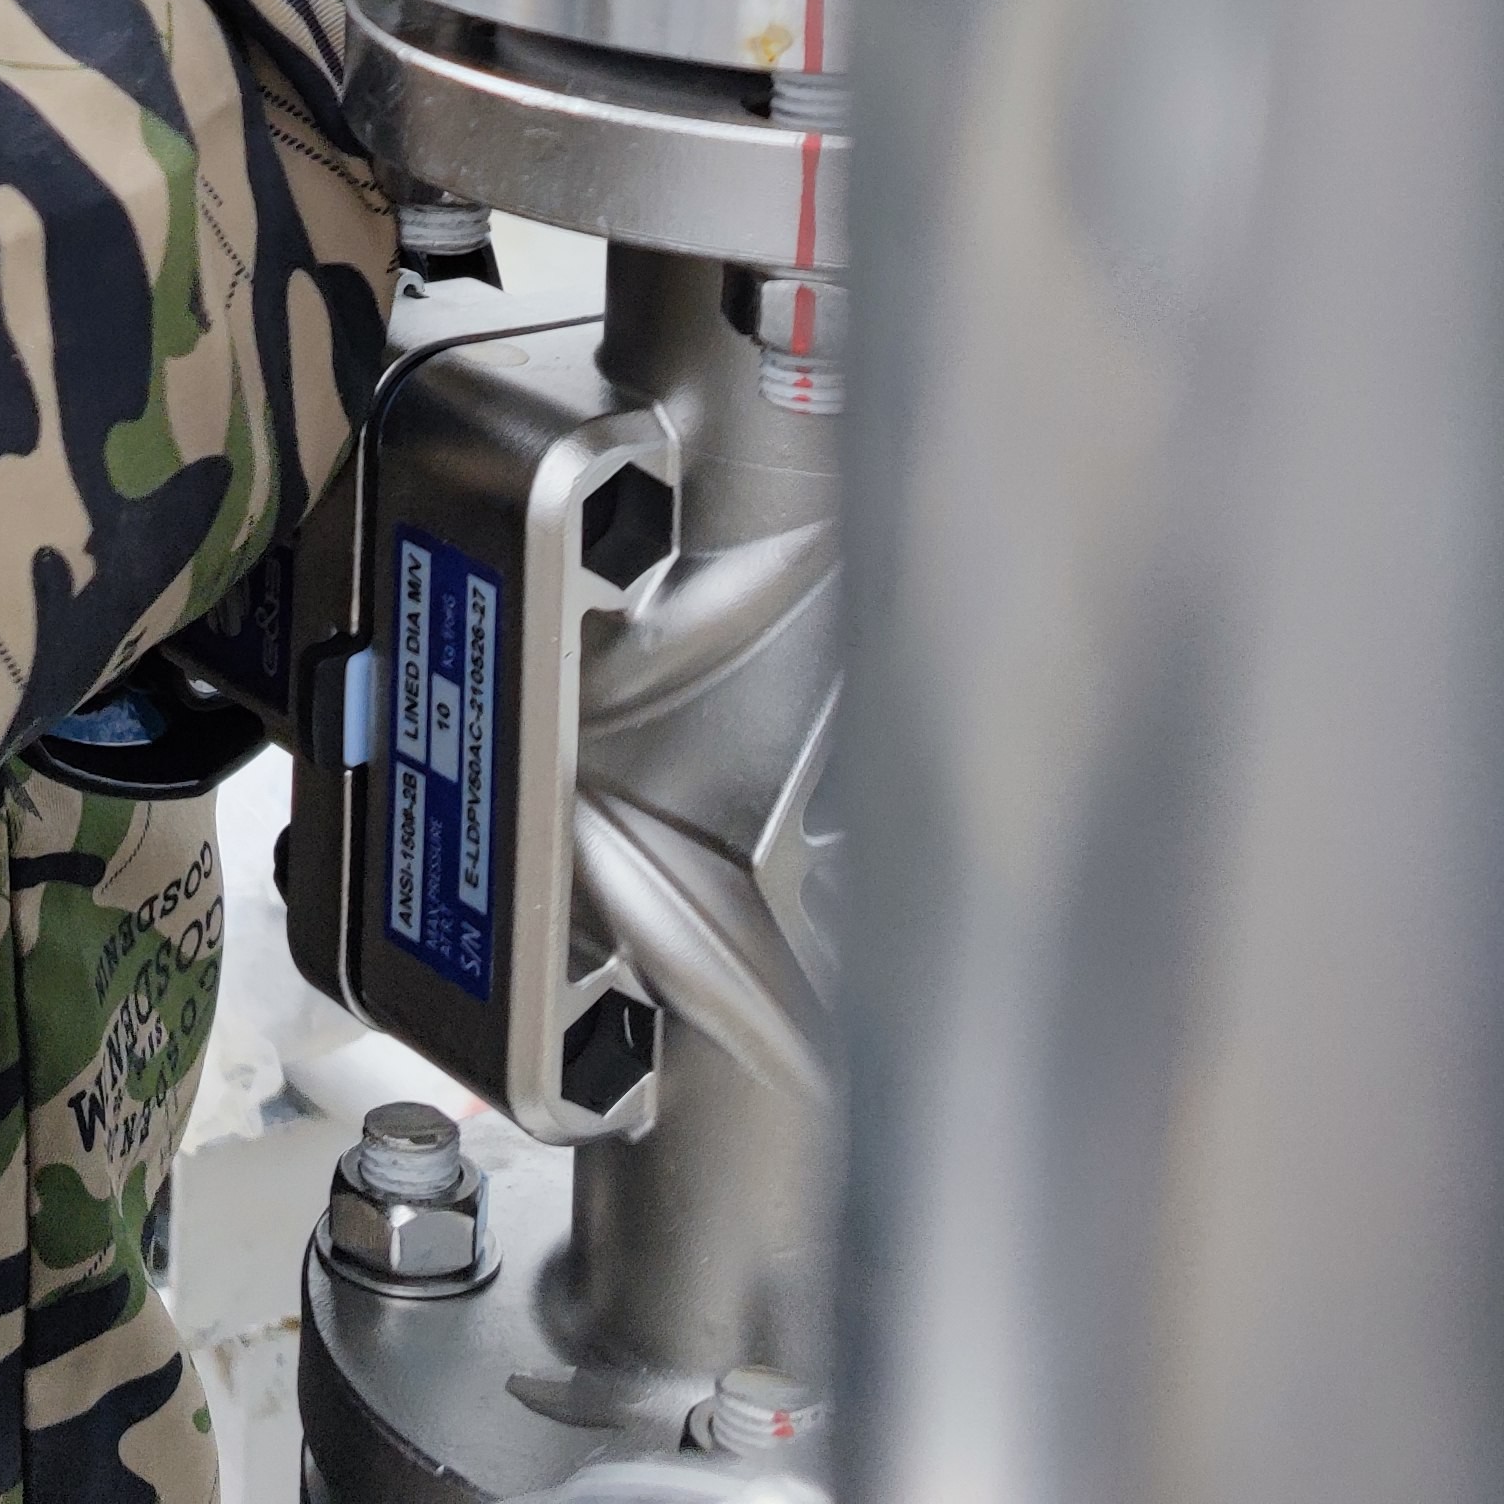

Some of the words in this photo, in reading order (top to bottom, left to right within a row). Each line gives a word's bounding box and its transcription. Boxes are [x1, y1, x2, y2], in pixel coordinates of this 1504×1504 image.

[406, 610, 422, 656] DIA
[404, 660, 420, 742] LINED
[435, 701, 452, 732] 10
[459, 920, 482, 978] S/N
